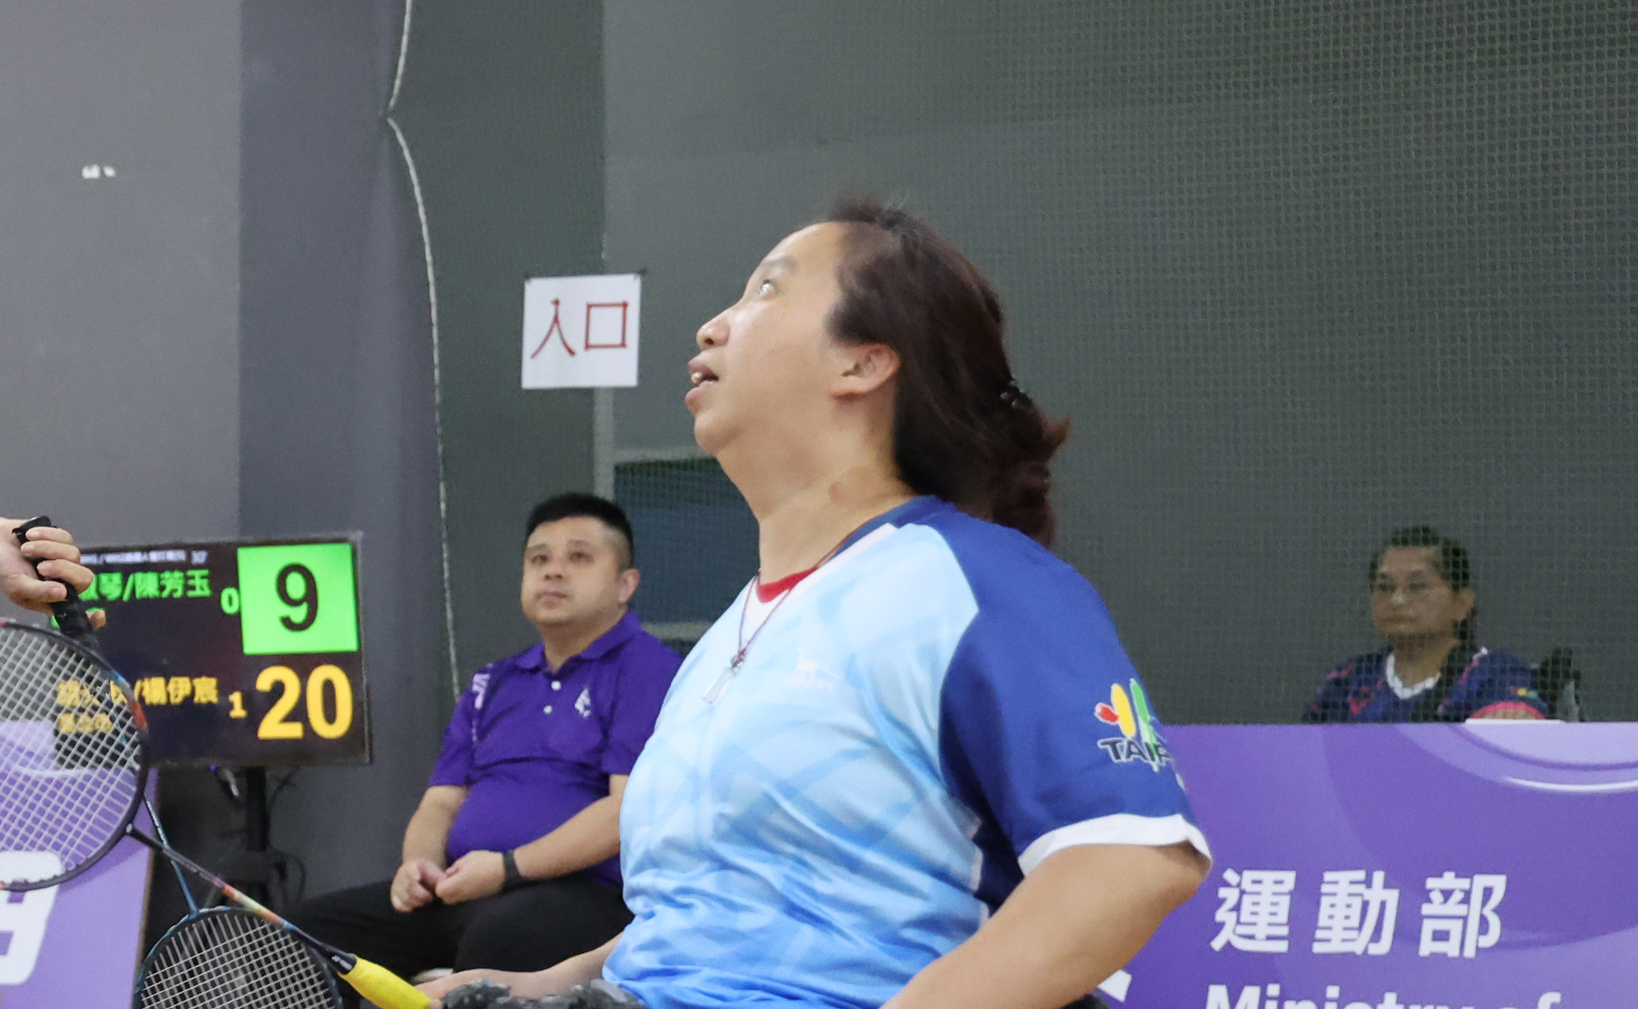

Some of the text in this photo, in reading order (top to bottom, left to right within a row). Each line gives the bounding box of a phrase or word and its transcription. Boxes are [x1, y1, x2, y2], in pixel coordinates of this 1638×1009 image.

[529, 297, 629, 359] 入口
[220, 587, 241, 615] 0
[275, 562, 319, 632] 9
[228, 690, 248, 719] 1
[255, 664, 354, 740] 20
[1209, 867, 1508, 959] 運動部
